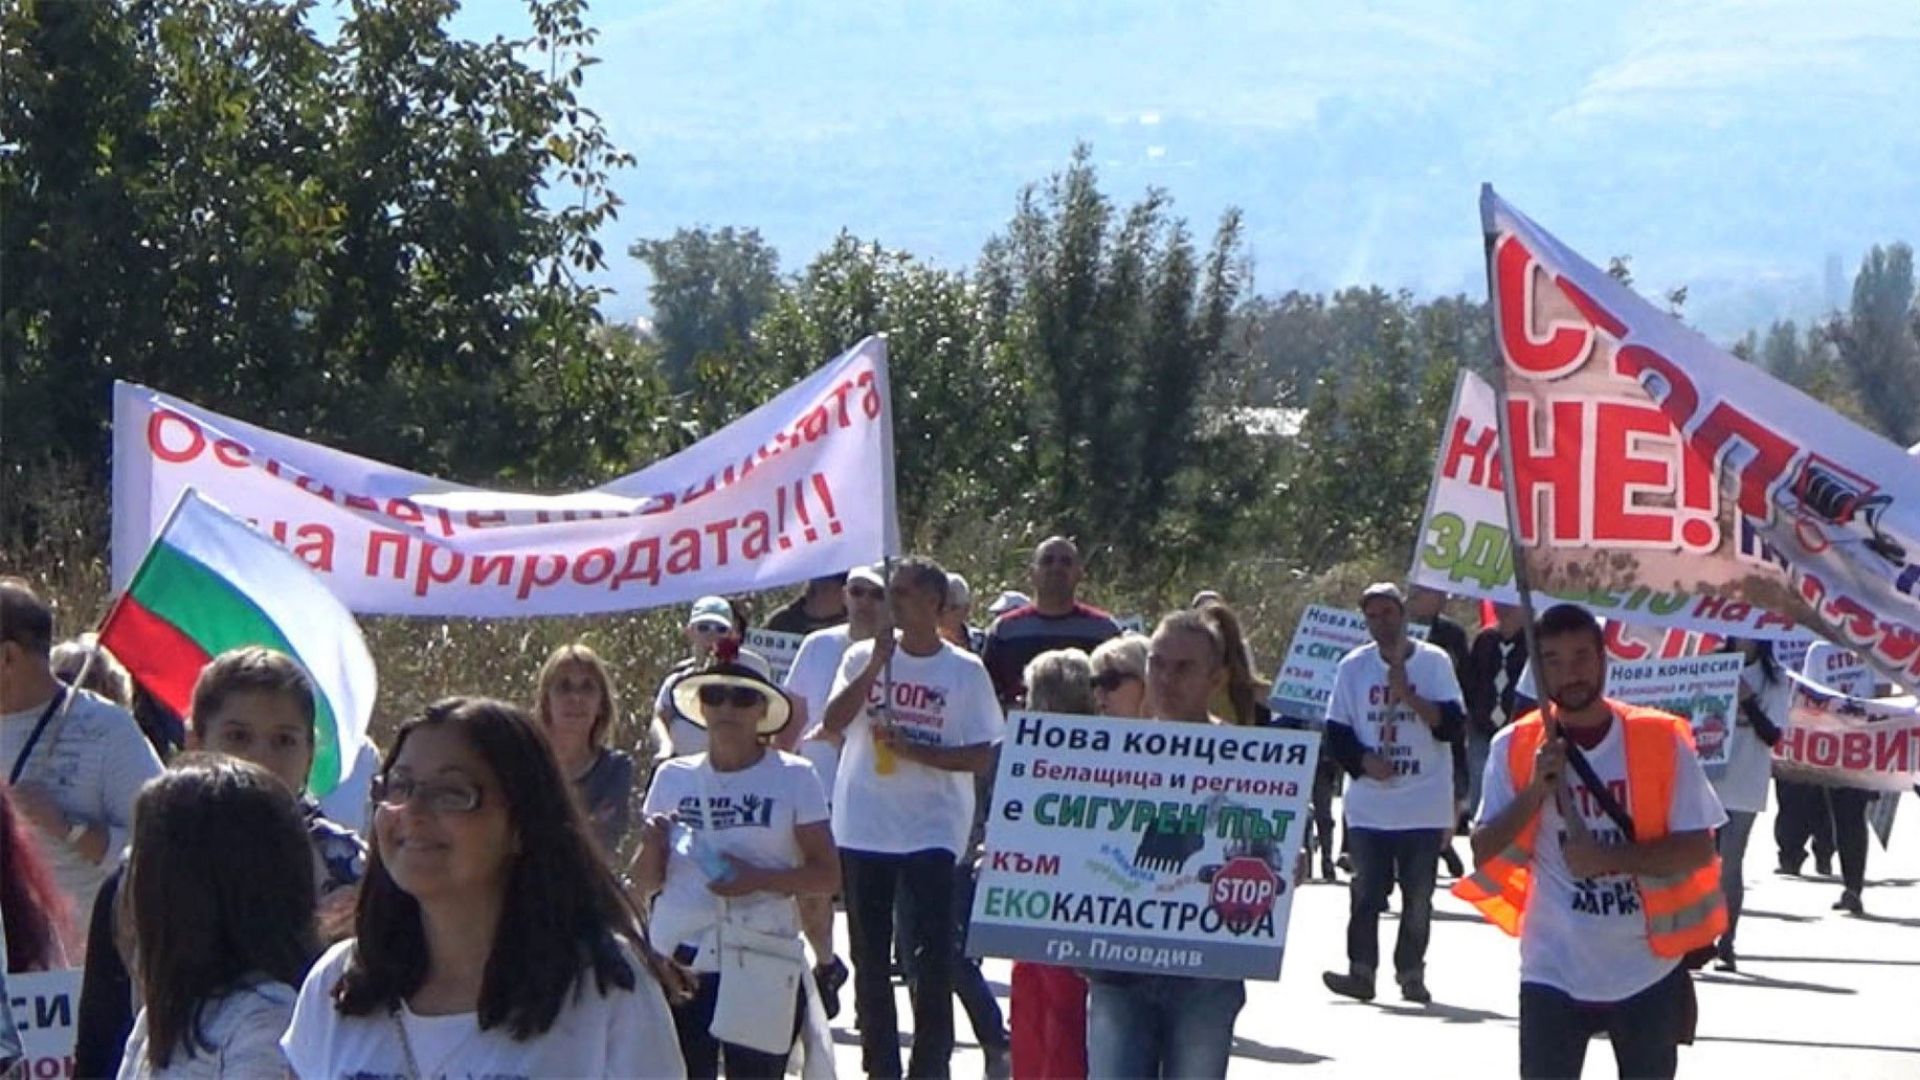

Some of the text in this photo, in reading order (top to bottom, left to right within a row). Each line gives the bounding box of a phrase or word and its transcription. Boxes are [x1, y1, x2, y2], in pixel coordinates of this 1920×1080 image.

[1497, 236, 1801, 520] СОП
[1507, 399, 1718, 548] НЕ!
[365, 473, 844, 600] природата!!!
[1610, 658, 1740, 681] Нова концесия
[1016, 718, 1308, 766] Нова концесия
[1010, 759, 1299, 798] в Белащица и региона
[1003, 793, 1297, 842] е СИГУРЕН ПЪТ
[991, 850, 1061, 877] към
[1214, 877, 1273, 905] STOP
[1046, 939, 1204, 968] гр. Пловдив
